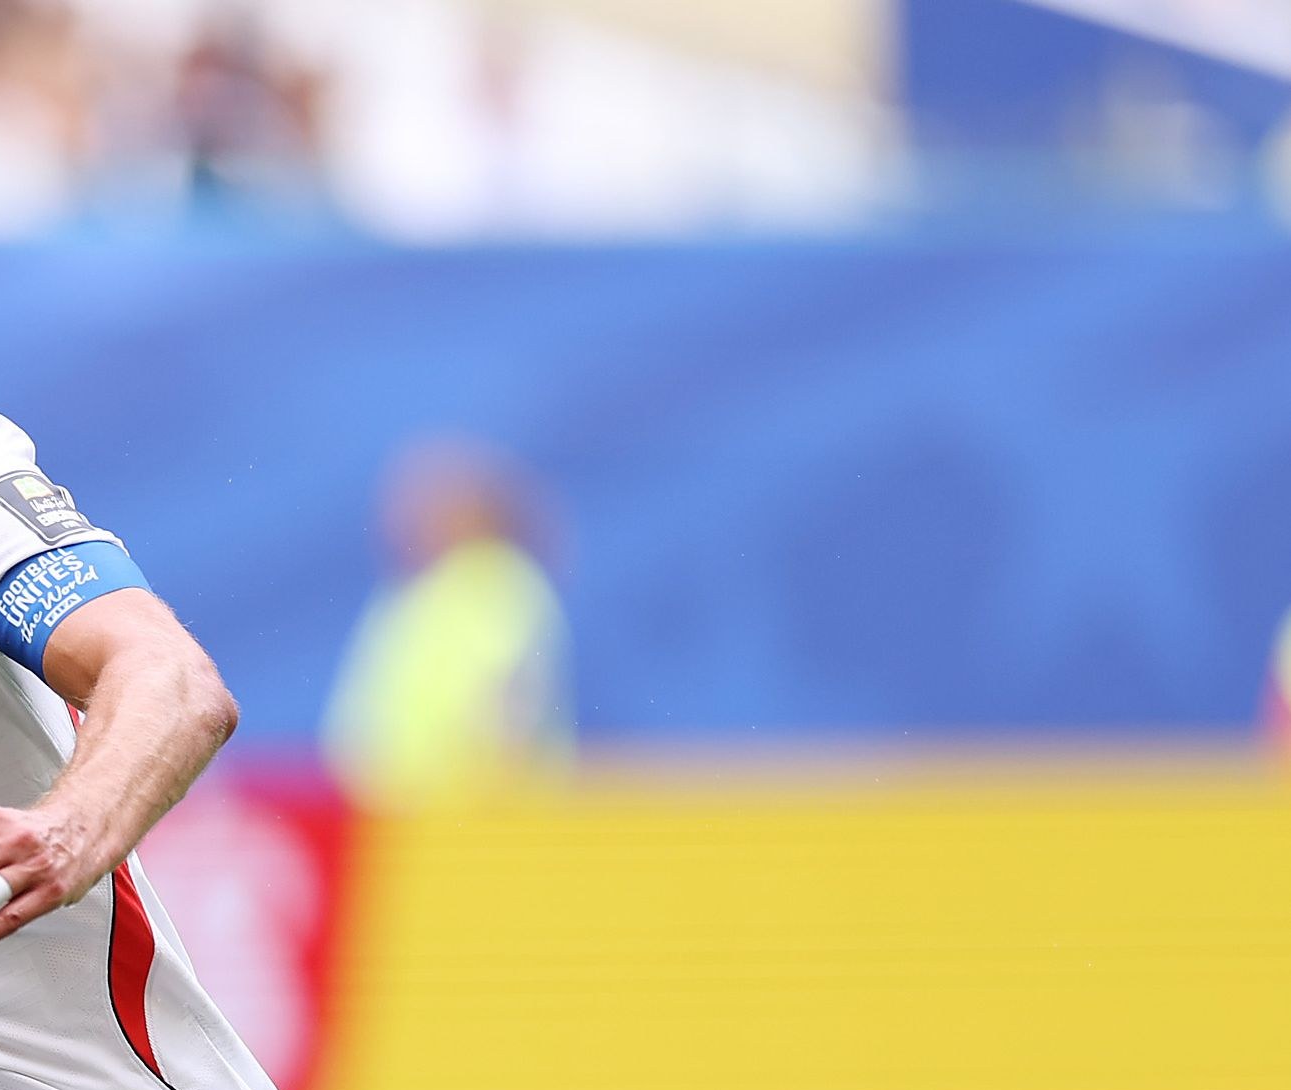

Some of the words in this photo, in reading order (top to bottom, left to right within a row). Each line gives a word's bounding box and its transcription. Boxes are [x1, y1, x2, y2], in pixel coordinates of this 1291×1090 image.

[6, 554, 84, 627] UNITES
[21, 610, 43, 644] the
[38, 565, 99, 610] World
